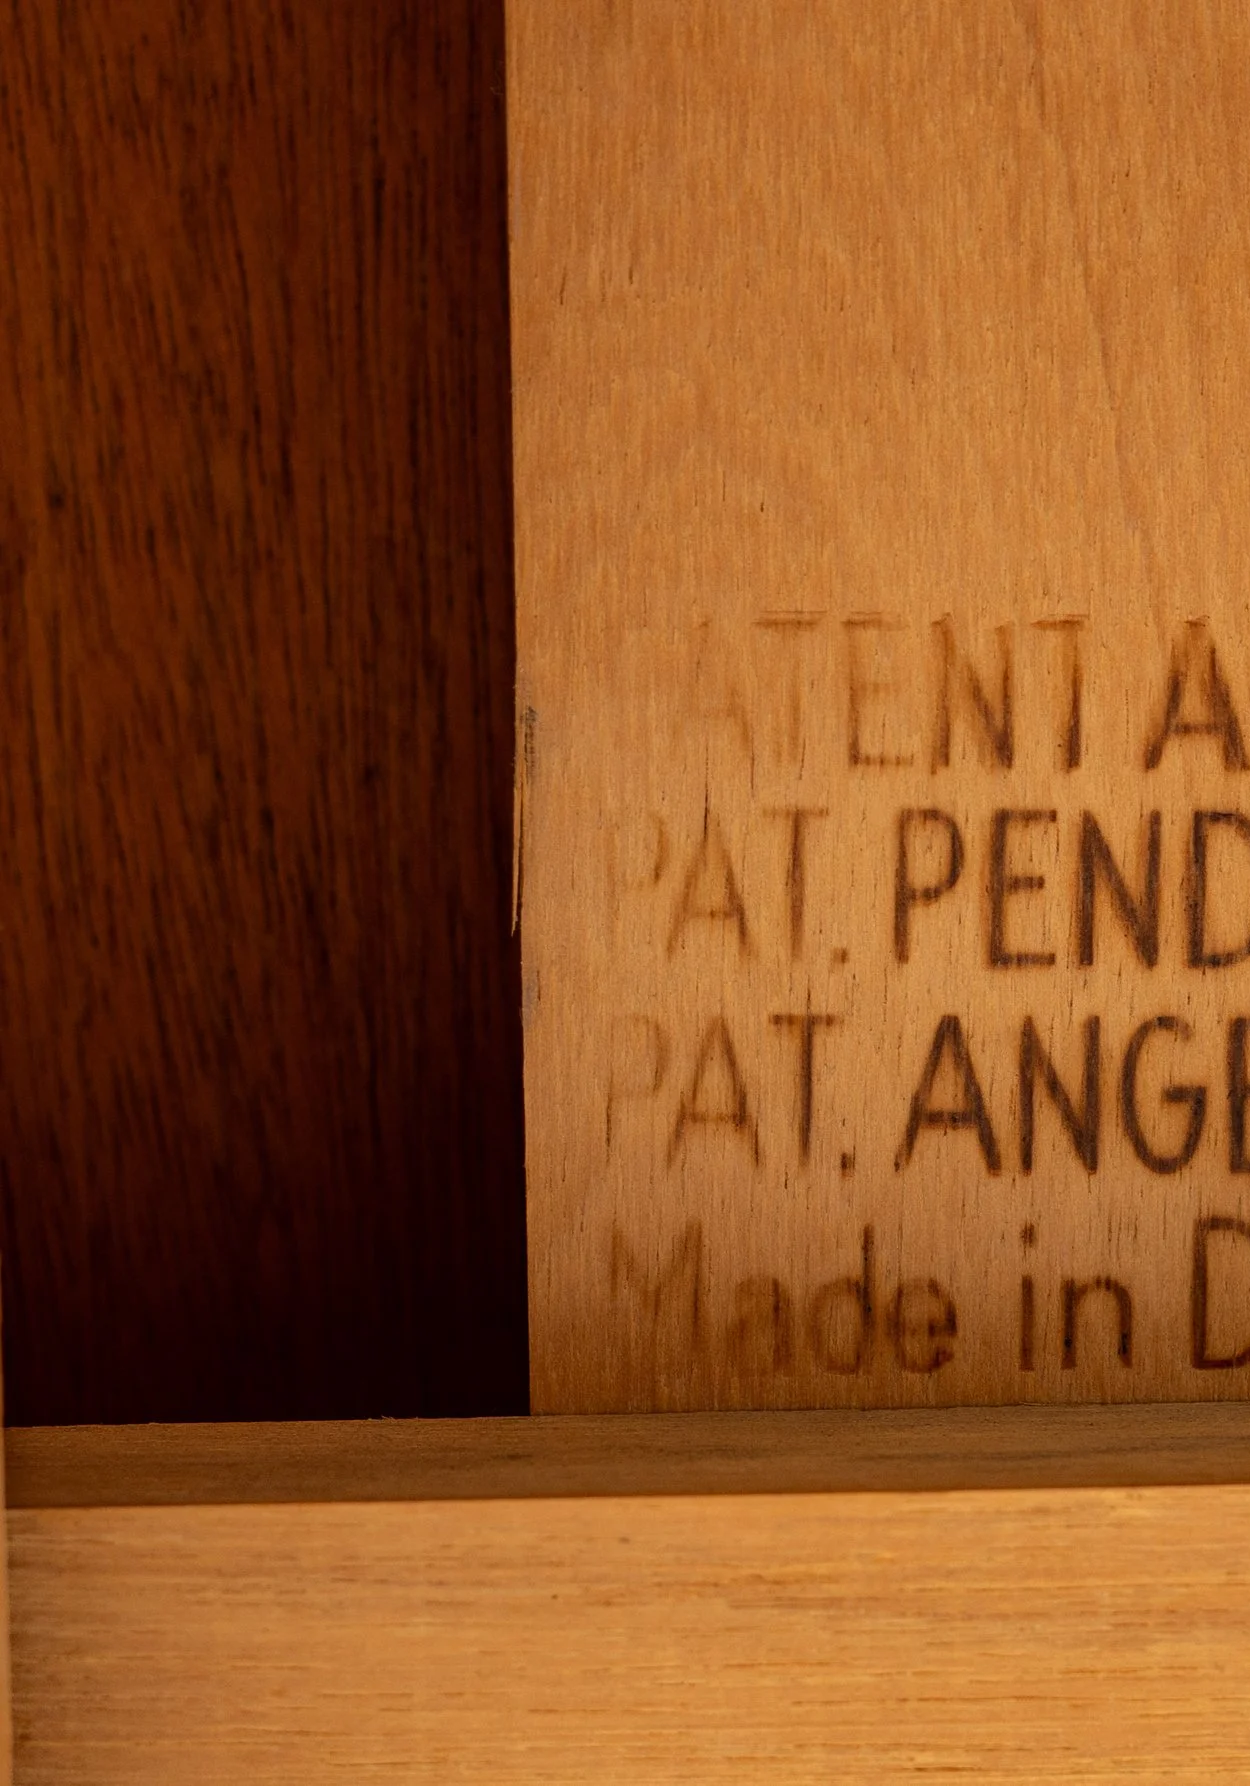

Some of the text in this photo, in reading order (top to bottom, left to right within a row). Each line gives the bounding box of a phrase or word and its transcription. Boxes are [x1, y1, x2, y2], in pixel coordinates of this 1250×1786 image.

[662, 610, 1090, 774] ATENT
[605, 808, 850, 965] PAT.
[605, 1012, 855, 1177] PAT.
[606, 1217, 959, 1375] Made
[1018, 1222, 1133, 1373] in
